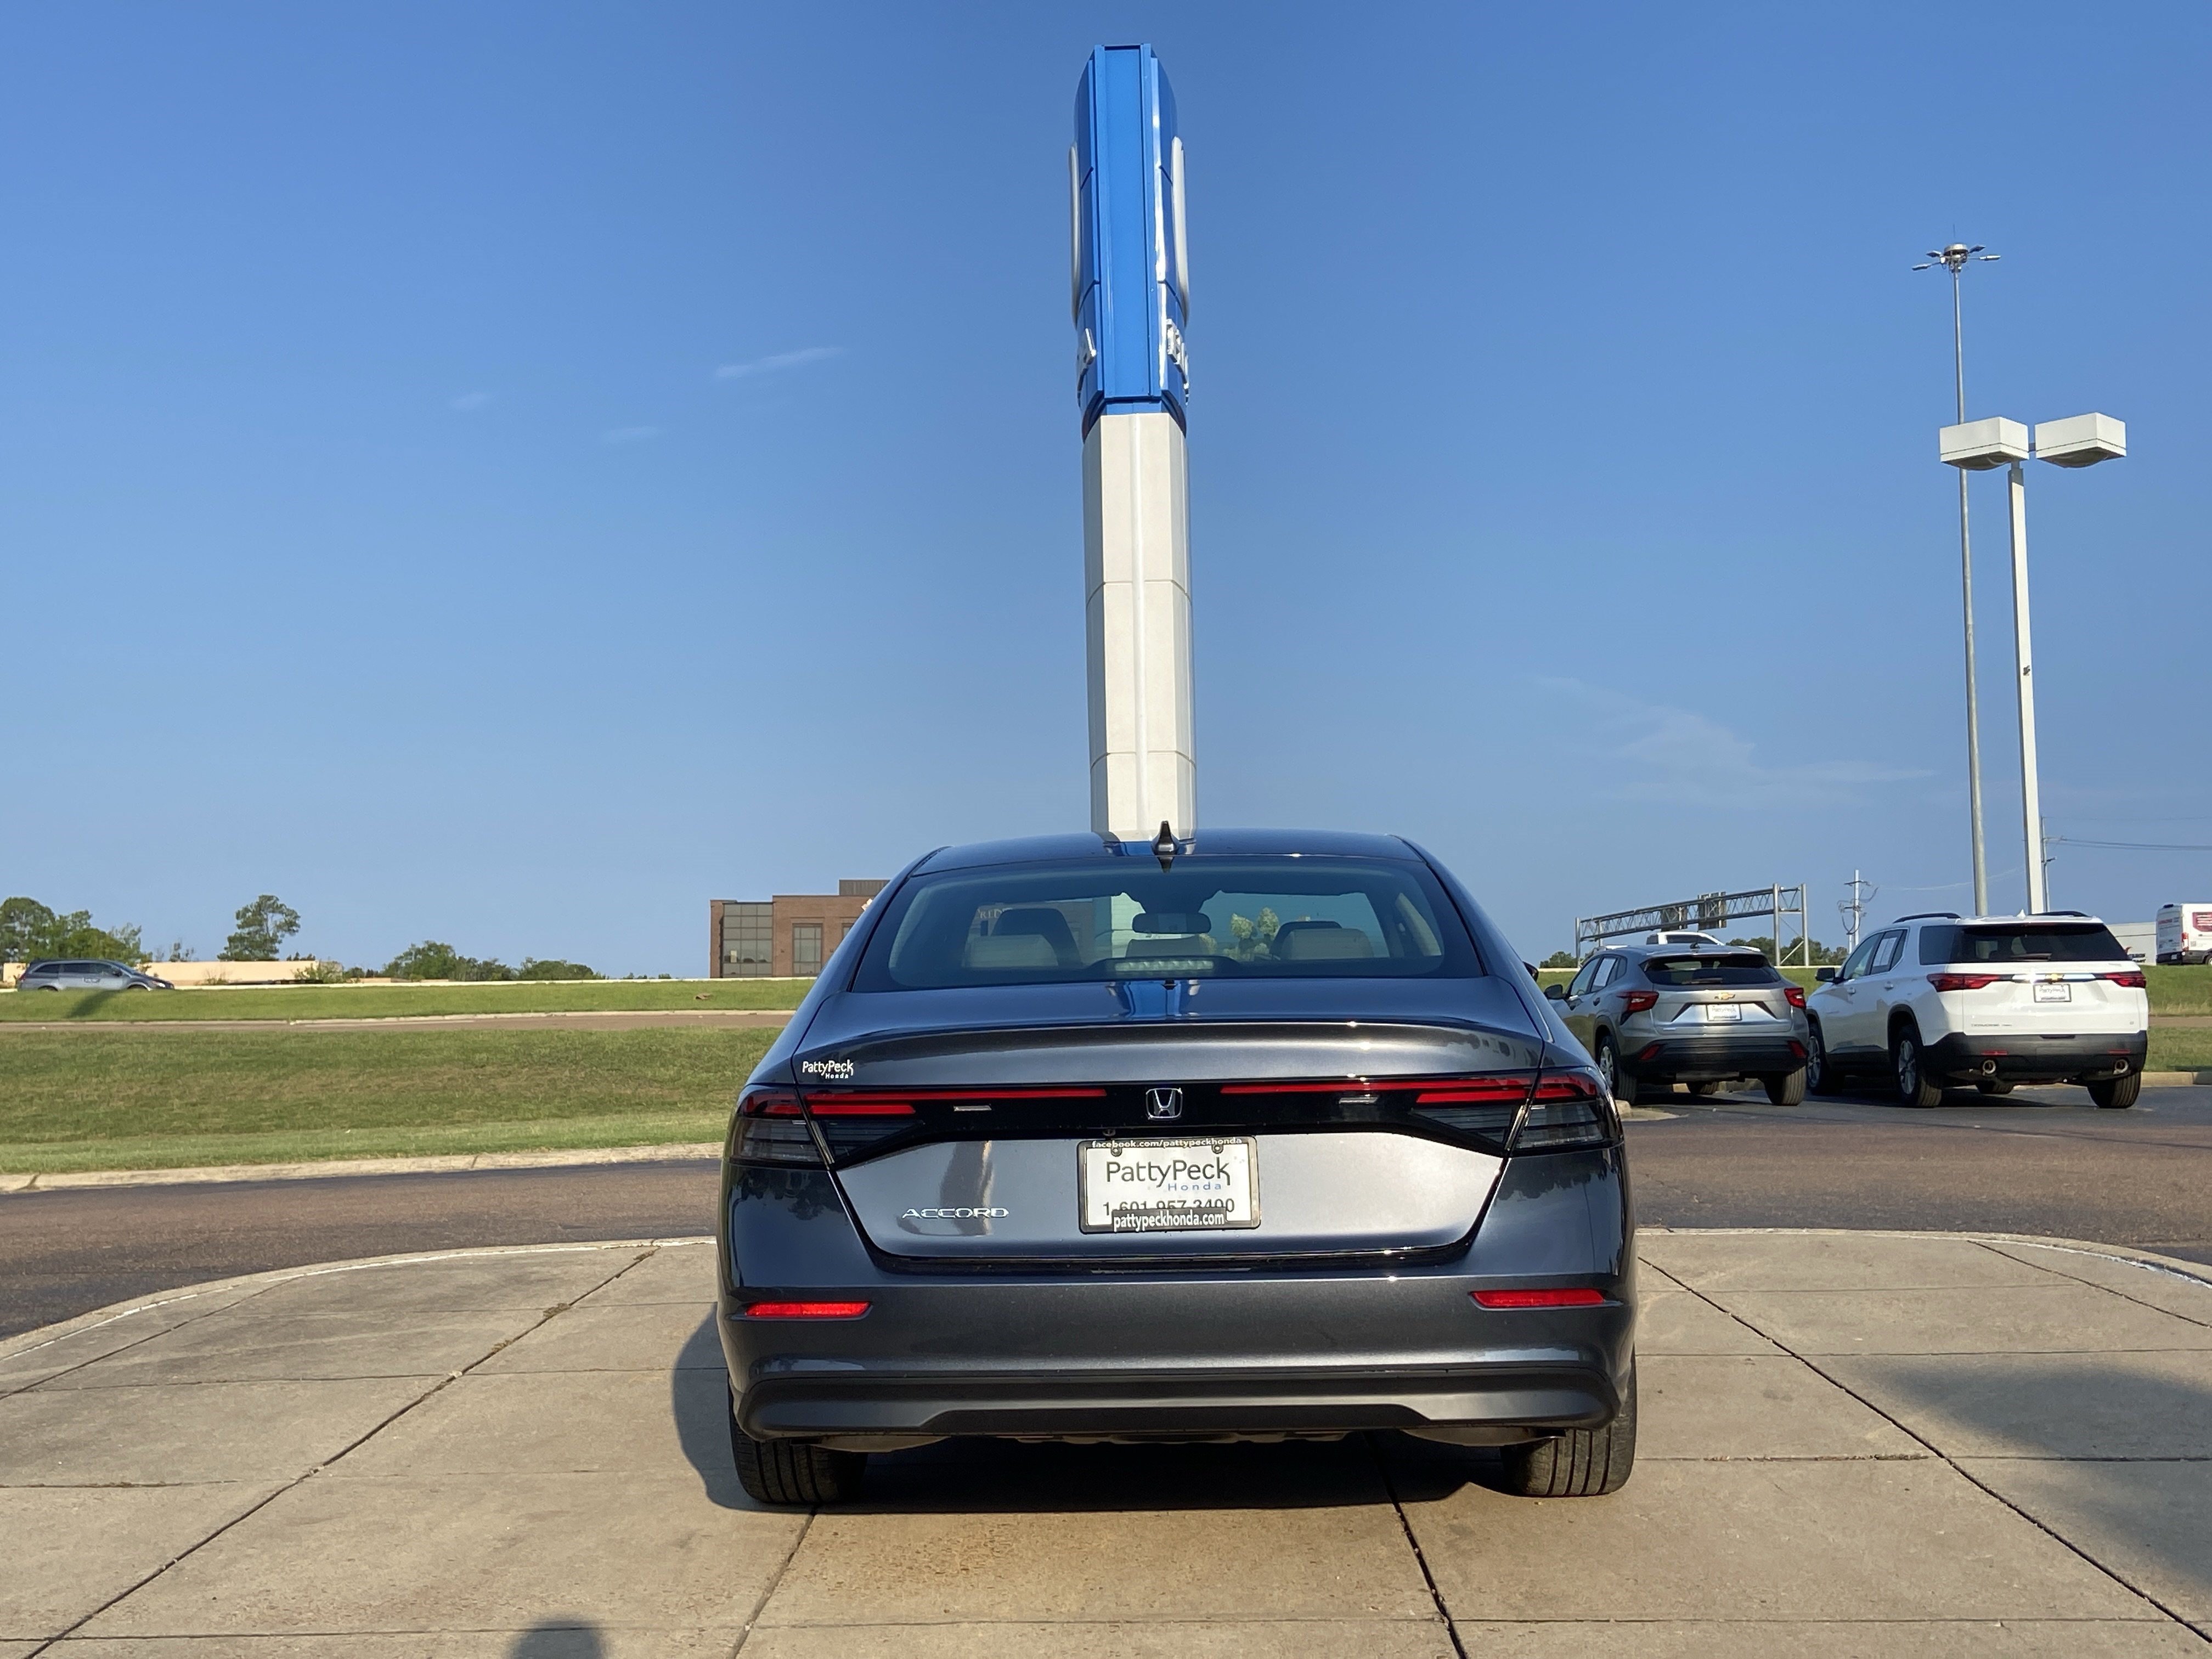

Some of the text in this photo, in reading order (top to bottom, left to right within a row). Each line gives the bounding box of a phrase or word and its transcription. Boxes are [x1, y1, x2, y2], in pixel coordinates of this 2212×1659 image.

[802, 1059, 854, 1076] PattyPeck
[1092, 1137, 1242, 1148] facebook.com/pattypeckhonda
[1106, 1156, 1231, 1188] PattyPeck
[1167, 1182, 1221, 1191] Honda
[901, 1207, 1009, 1218] ACCORD
[1113, 1209, 1224, 1232] pattypeckhonda.com
